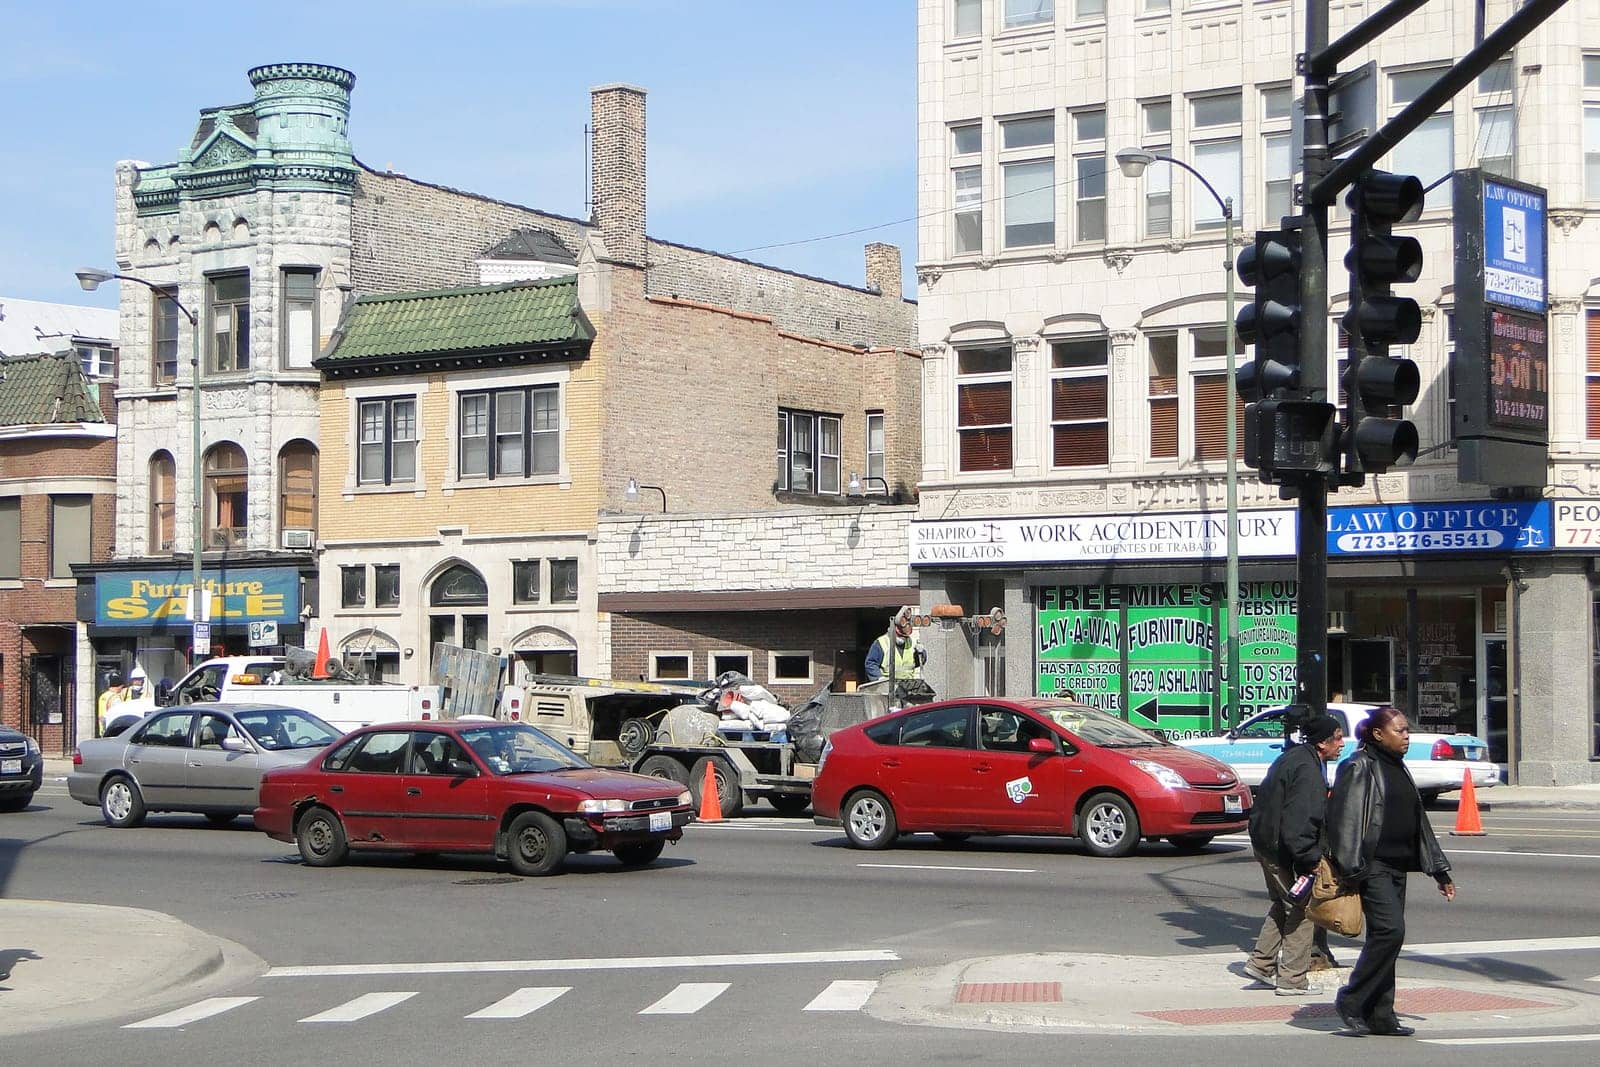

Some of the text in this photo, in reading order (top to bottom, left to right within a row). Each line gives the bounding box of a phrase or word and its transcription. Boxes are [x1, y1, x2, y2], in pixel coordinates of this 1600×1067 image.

[1486, 184, 1541, 210] LAW OFFICE
[1327, 508, 1519, 532] LAW OFFICE
[918, 527, 976, 540] SHAPIRO
[1020, 518, 1283, 542] WORK ACCIDENT/INURY
[1080, 541, 1217, 555] ACCIDENTES DE TRABAJO
[1351, 533, 1490, 550] 773-276-5541
[918, 546, 1004, 559] & VASILATOS
[131, 579, 263, 598] Furniture
[1040, 585, 1120, 610] FREE
[1128, 584, 1213, 607] MIKE'S
[107, 593, 285, 619] SALE
[1237, 600, 1297, 616] EBSITE
[1128, 617, 1213, 652] FURNITURE
[1040, 663, 1082, 675] HASTA
[1244, 665, 1264, 682] TO
[1055, 677, 1107, 689] DE CREDITO
[1129, 668, 1213, 694] 1259 ASHLAND
[1239, 685, 1297, 701] NSTANT
